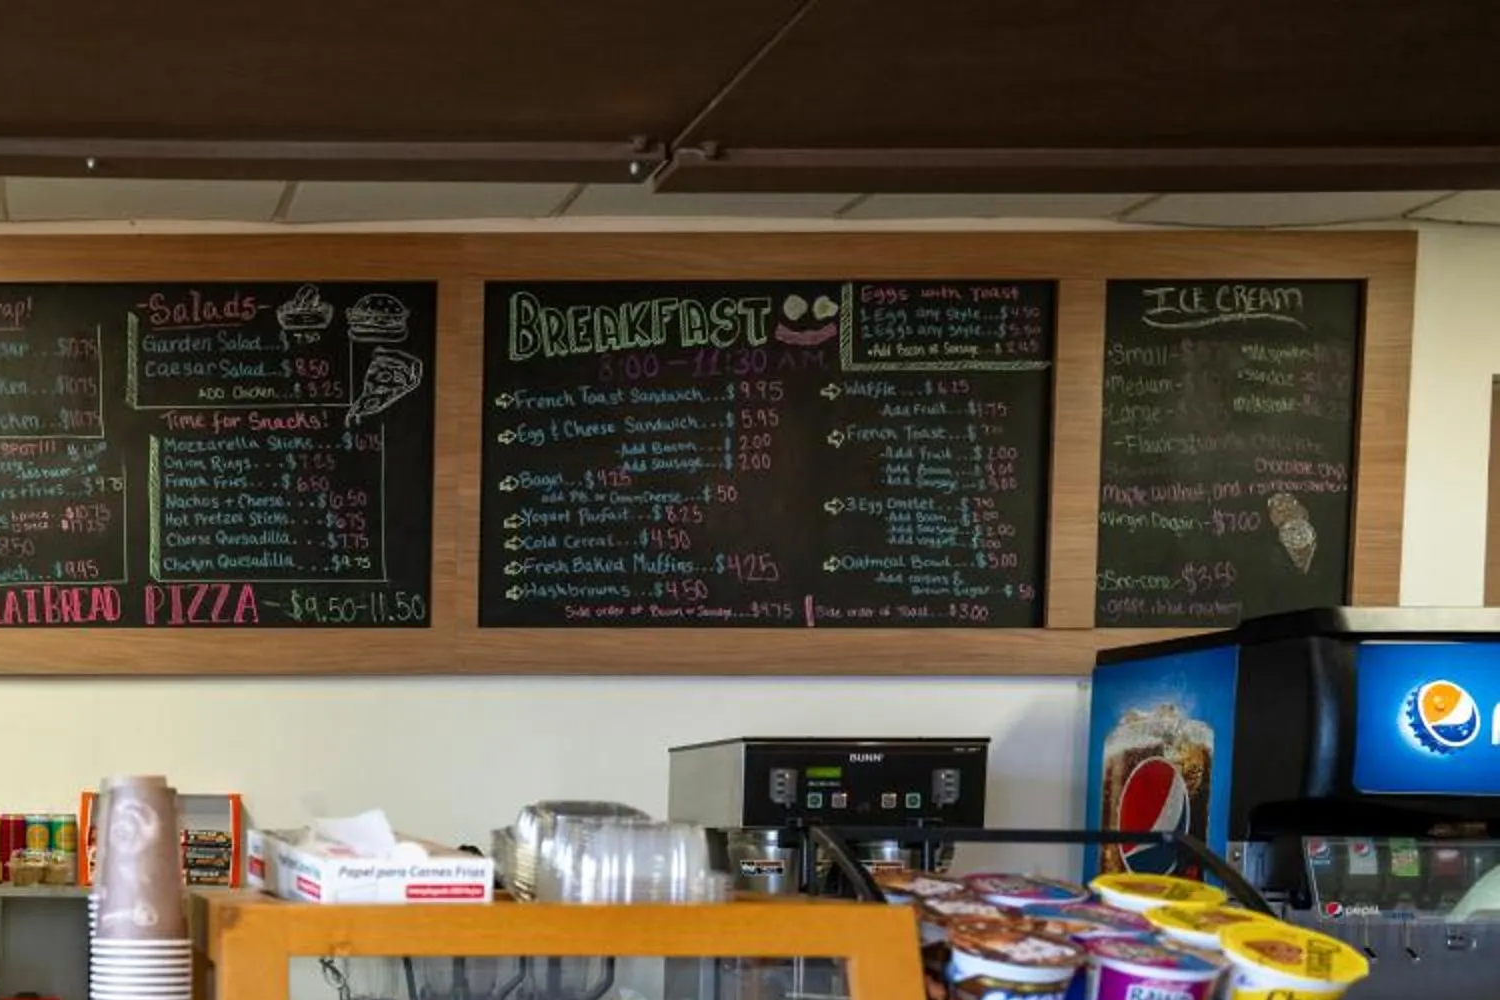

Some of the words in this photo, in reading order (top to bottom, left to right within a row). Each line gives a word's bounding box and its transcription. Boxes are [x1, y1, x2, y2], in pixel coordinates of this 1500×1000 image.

[1143, 287, 1208, 314] ICE
[1216, 285, 1303, 312] CREAM
[509, 291, 771, 362] BREAKFAST
[142, 335, 212, 353] Garden
[217, 330, 261, 351] Salad
[145, 360, 216, 378] Caesar
[218, 360, 265, 377] Salad
[579, 386, 623, 406] Toast
[159, 411, 206, 430] Time
[211, 412, 242, 435] for
[624, 416, 701, 434] Sandwich
[162, 437, 260, 453] Mozzarella
[211, 455, 250, 475] Rings
[165, 511, 189, 526] Hot
[523, 535, 557, 550] Cold
[522, 556, 569, 574] Fresh
[573, 557, 624, 573] Baked
[633, 553, 694, 575] Muffins
[840, 555, 905, 571] Oatmeal
[145, 582, 258, 624] PIZZA
